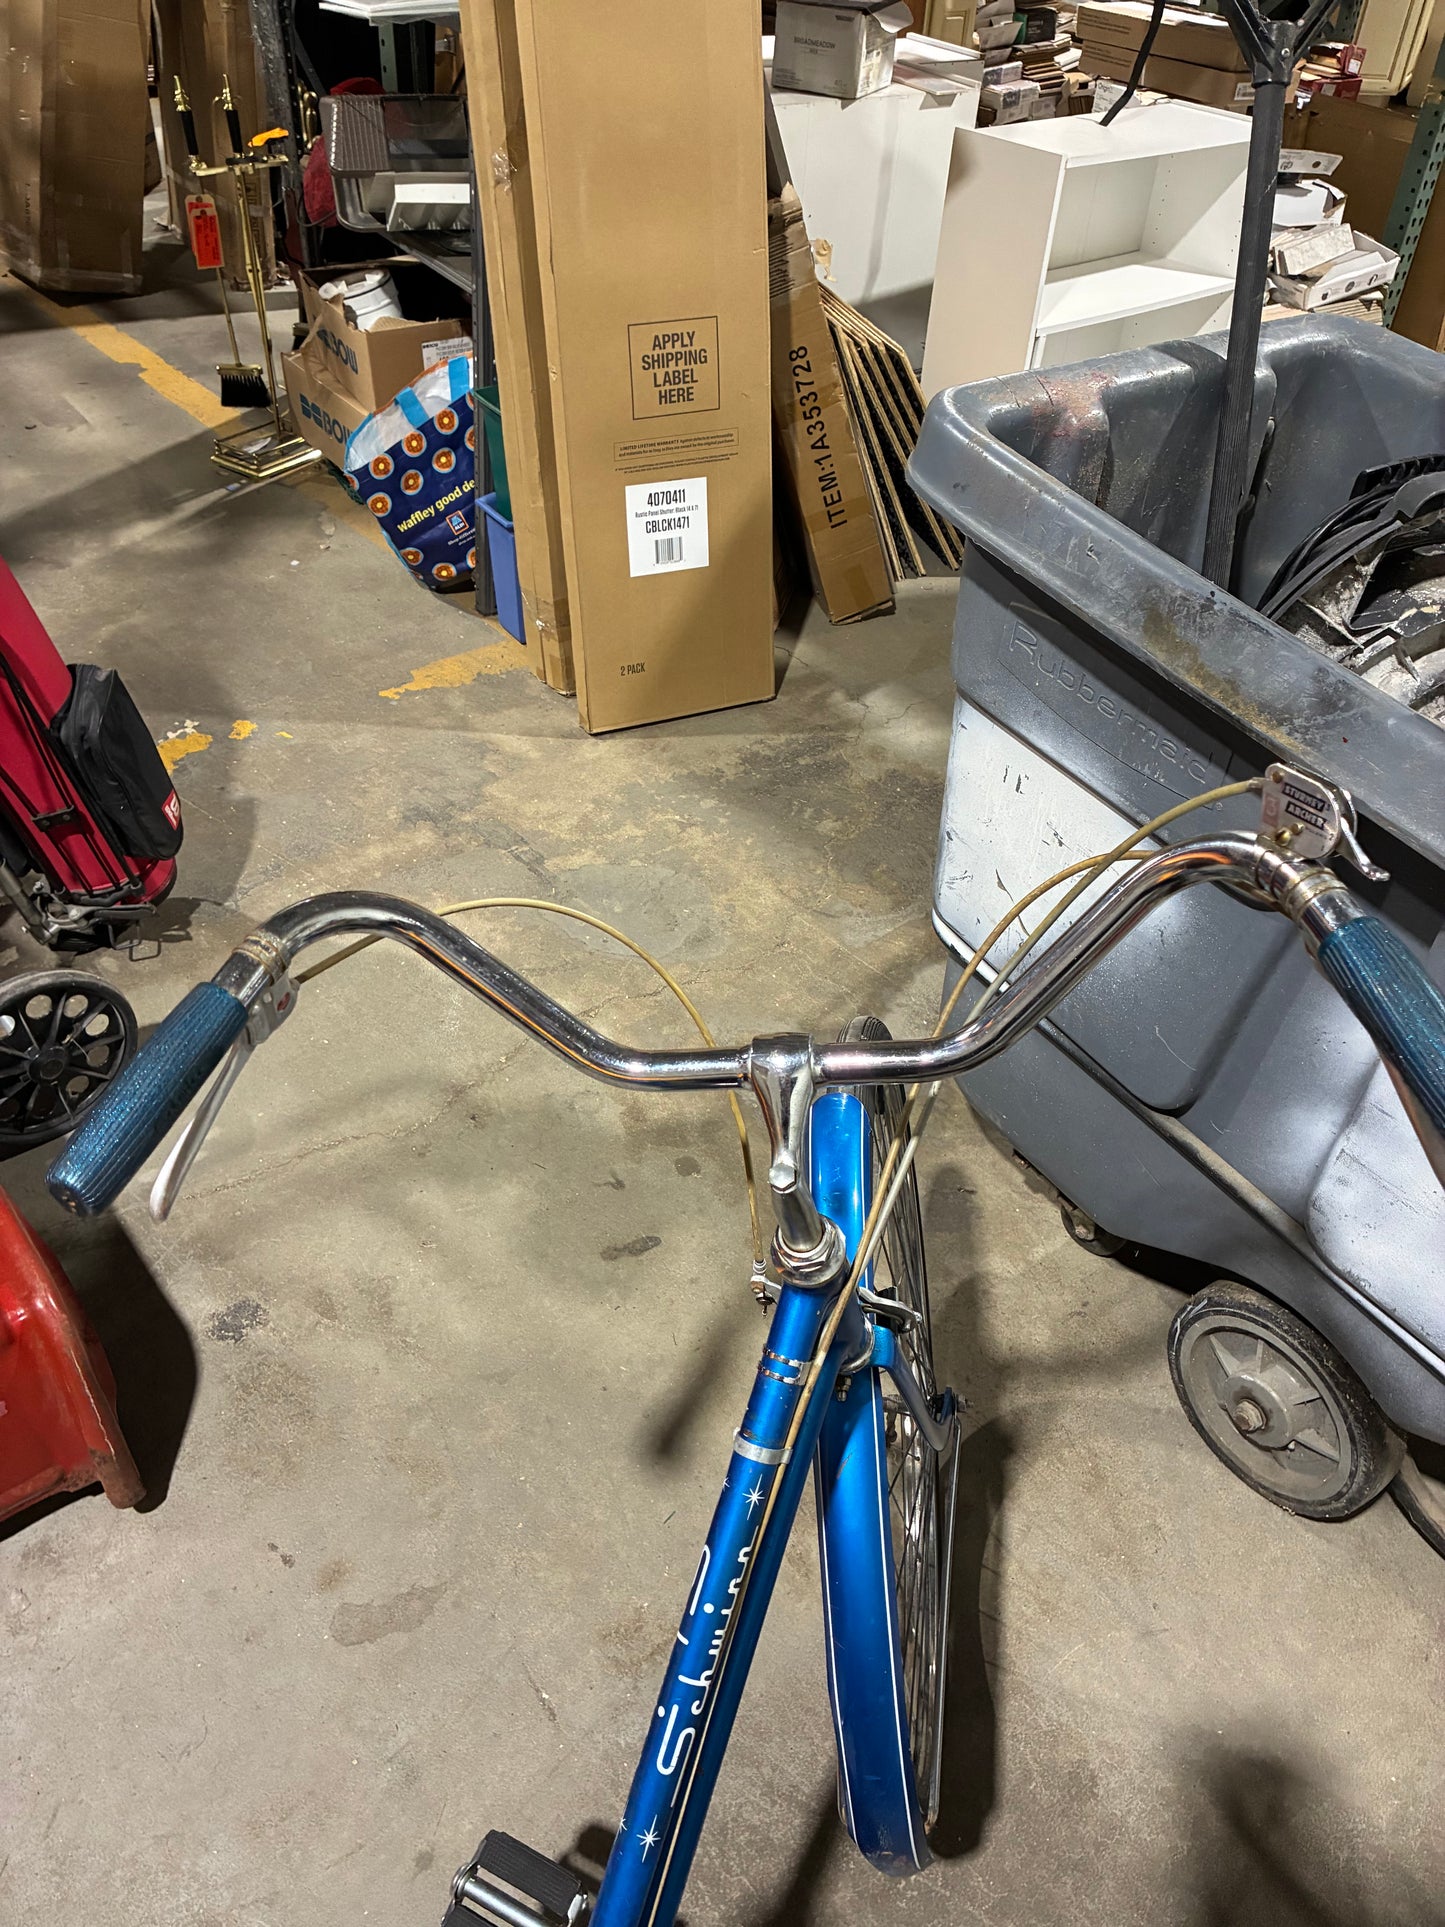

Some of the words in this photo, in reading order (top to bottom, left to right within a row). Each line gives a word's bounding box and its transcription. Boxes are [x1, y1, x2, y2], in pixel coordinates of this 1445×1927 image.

[652, 331, 695, 351] APPLY
[641, 348, 708, 371] SHIPPING
[653, 368, 698, 388] LABEL
[658, 386, 694, 405] HERE
[789, 345, 848, 529] ITEM:1A353728
[435, 486, 462, 511] good
[647, 488, 686, 507] 4070411
[454, 522, 465, 530] ALDI
[645, 515, 690, 534] CBLCK1471
[620, 665, 626, 677] 2
[627, 662, 646, 675] PACK
[1009, 620, 1213, 785] Rubbermaid
[1284, 784, 1325, 811] STURMEY
[1287, 803, 1325, 829] ARCHER
[656, 1525, 759, 1808] Schwinn
